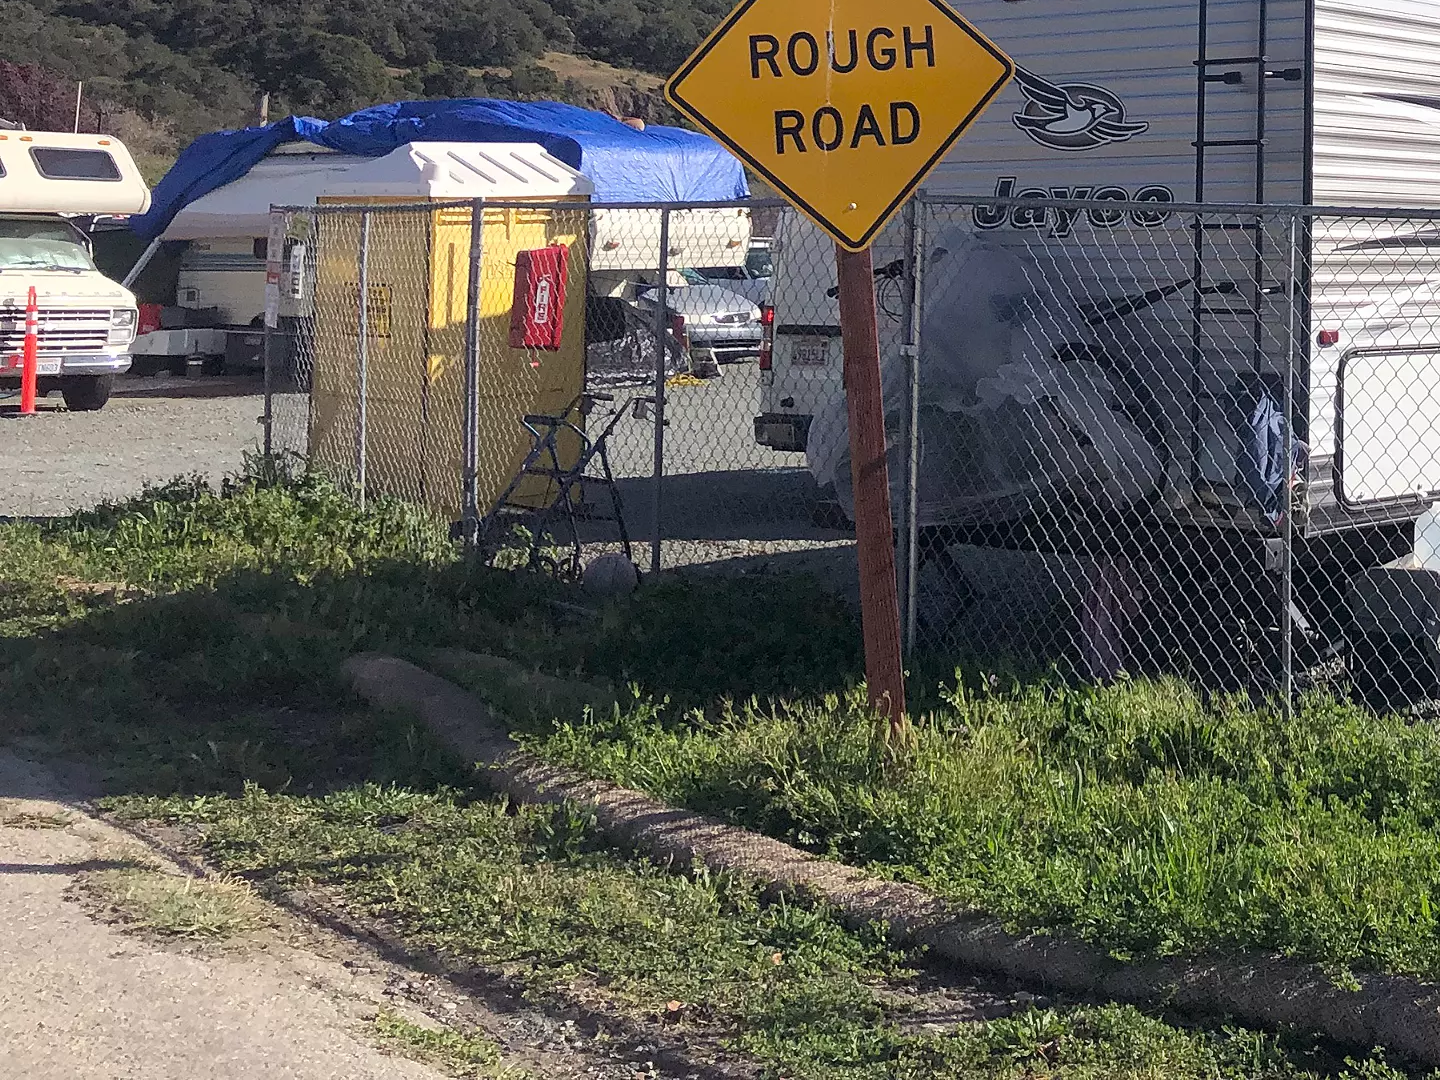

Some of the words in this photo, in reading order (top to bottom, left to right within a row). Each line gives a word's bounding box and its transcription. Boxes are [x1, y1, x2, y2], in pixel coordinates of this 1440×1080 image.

[748, 25, 936, 79] ROUGH
[773, 101, 921, 155] ROAD
[537, 286, 547, 321] FIRE
